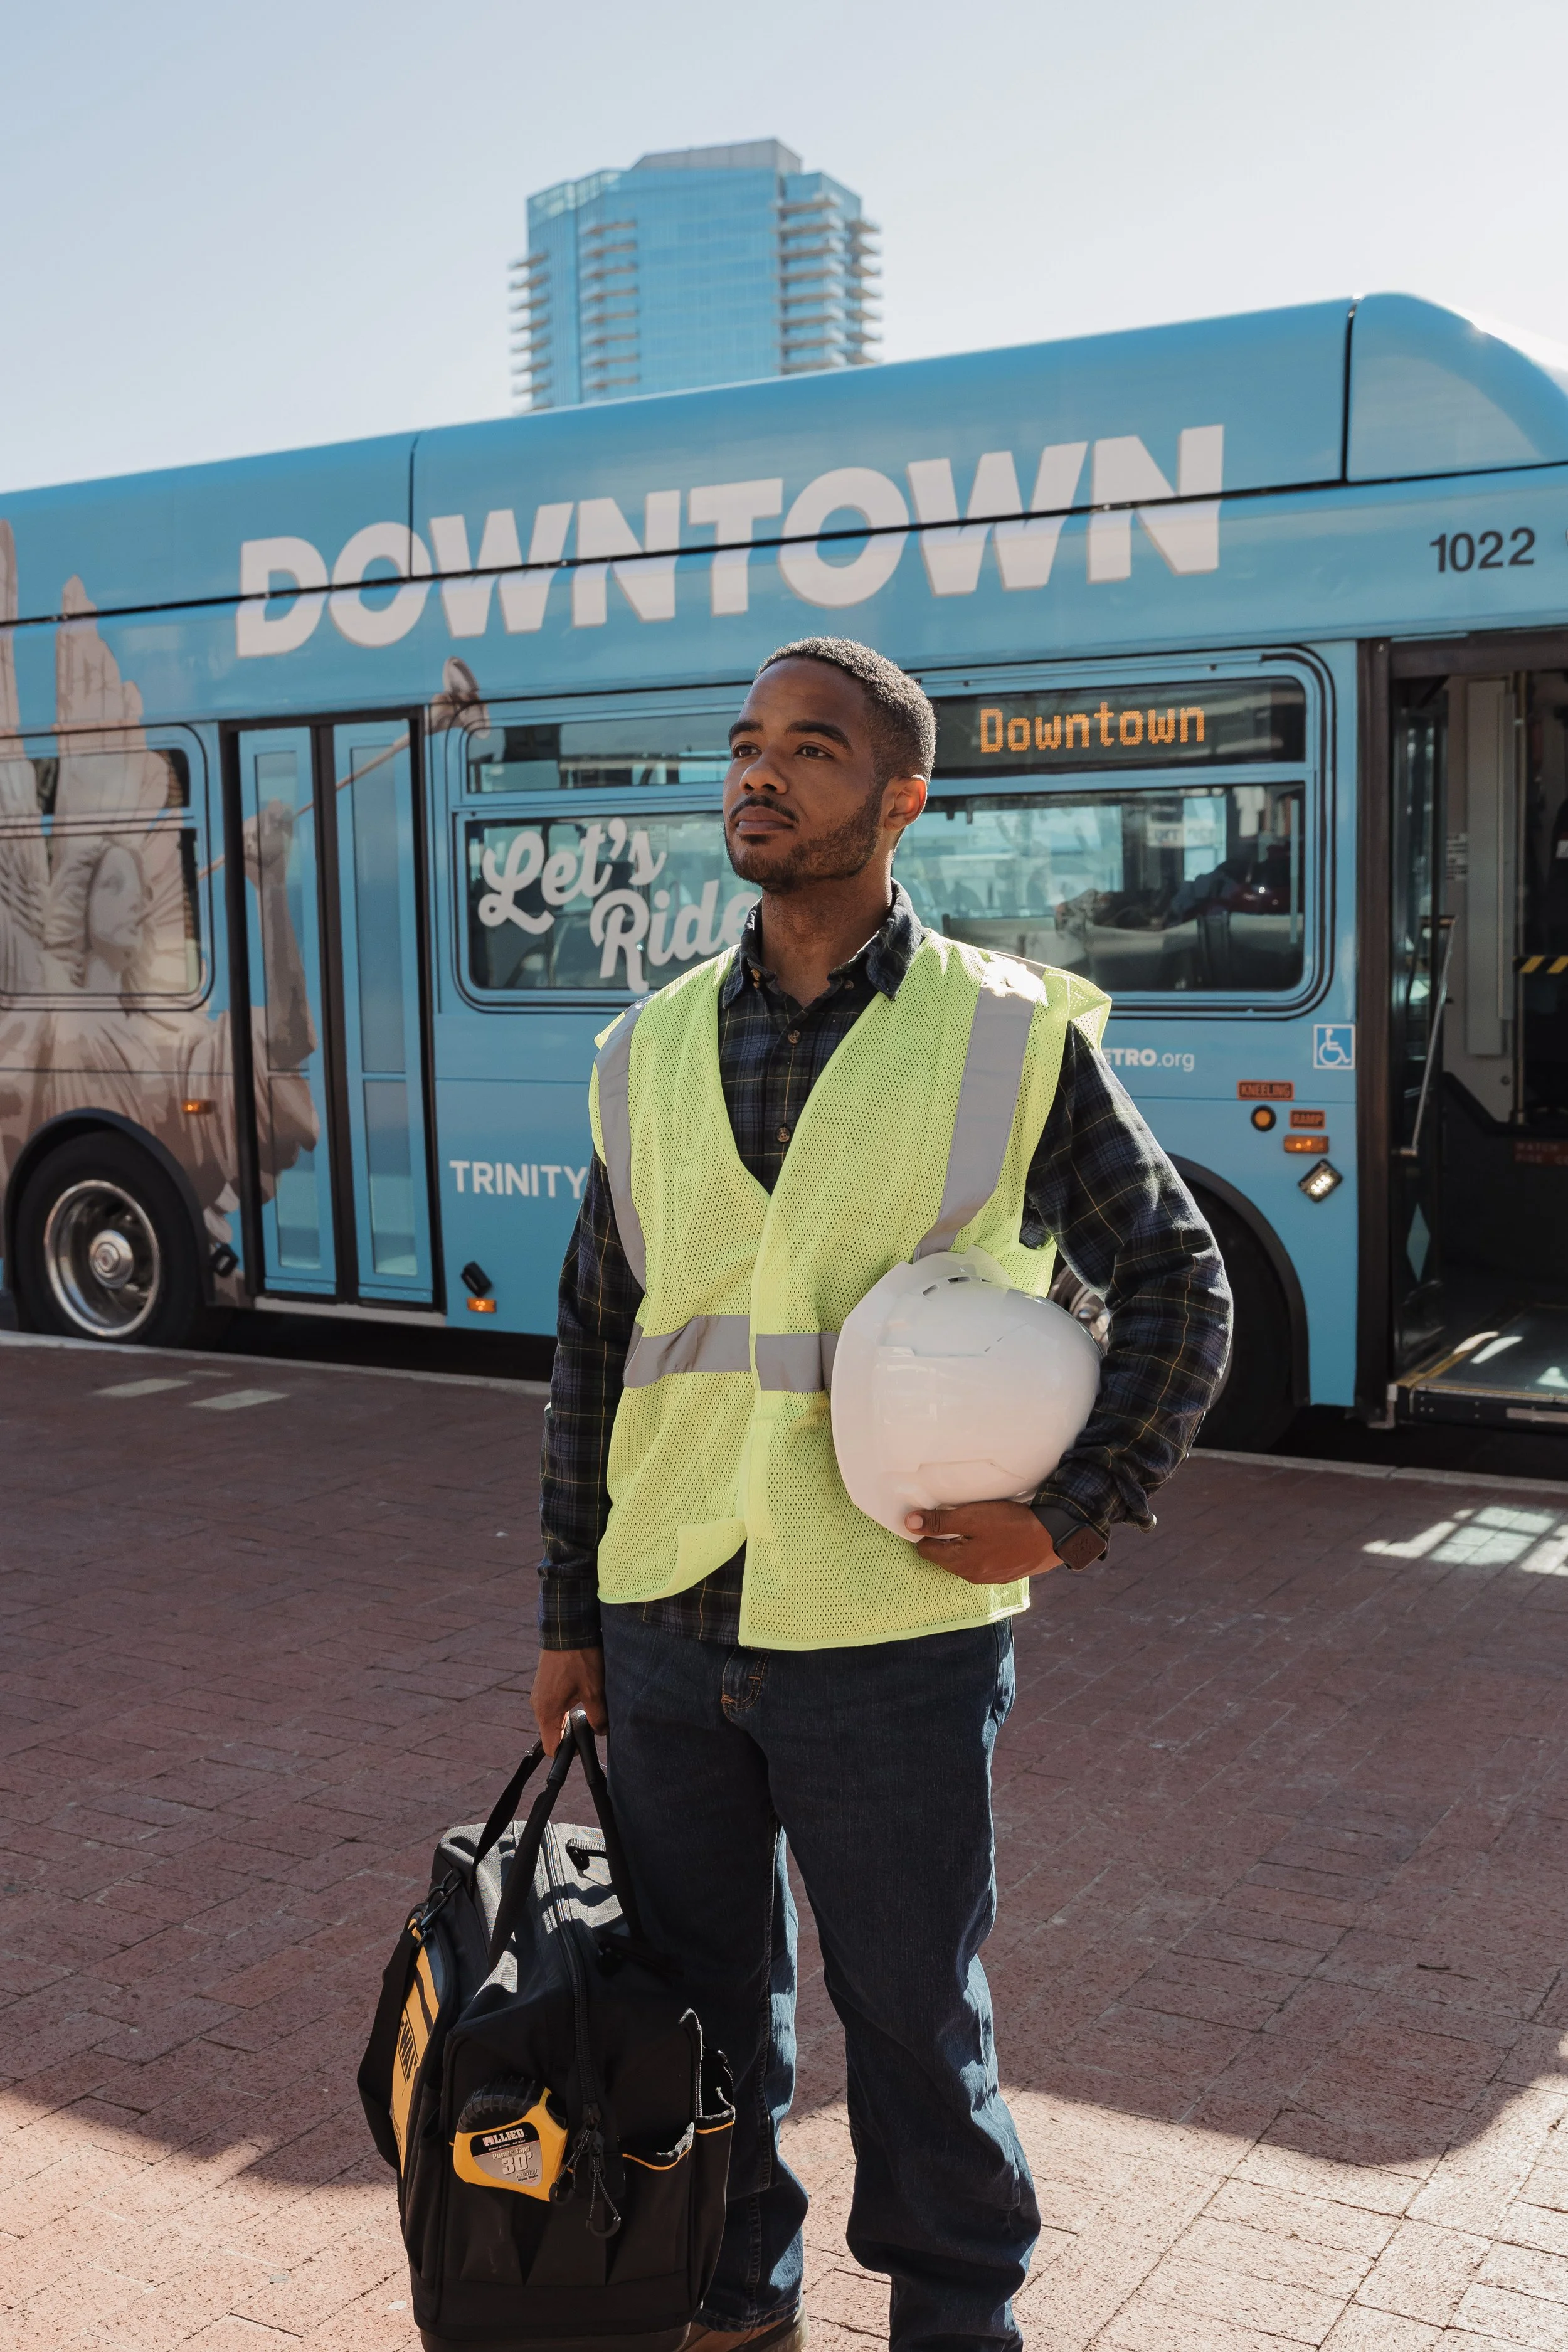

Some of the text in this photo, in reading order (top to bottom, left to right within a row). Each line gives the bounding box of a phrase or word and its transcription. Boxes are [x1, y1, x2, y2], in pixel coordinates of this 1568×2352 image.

[236, 423, 1225, 658] DOWNTOWN
[1429, 527, 1536, 573] 1022
[980, 702, 1205, 753] Downtown
[478, 817, 667, 935] Let's
[589, 879, 762, 995] Ride
[449, 1160, 588, 1199] TRINITY
[482, 2129, 525, 2146] ALLIED
[492, 2146, 531, 2160] Power Tape
